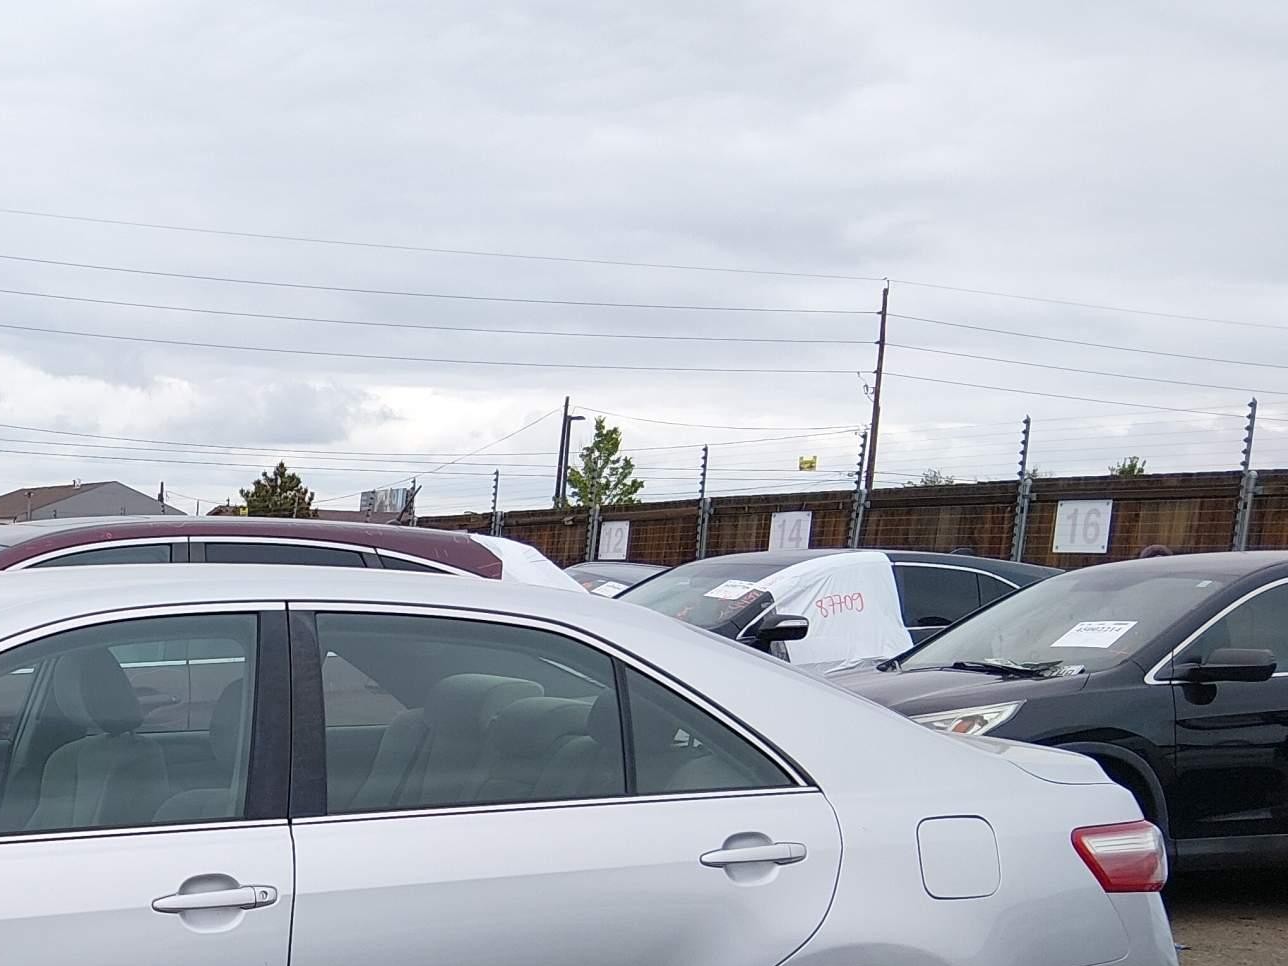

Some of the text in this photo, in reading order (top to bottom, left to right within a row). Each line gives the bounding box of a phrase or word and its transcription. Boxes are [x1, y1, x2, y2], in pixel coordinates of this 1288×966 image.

[777, 518, 802, 543] 14
[1066, 508, 1101, 544] 16
[604, 526, 623, 553] 12
[816, 592, 864, 618] 87709
